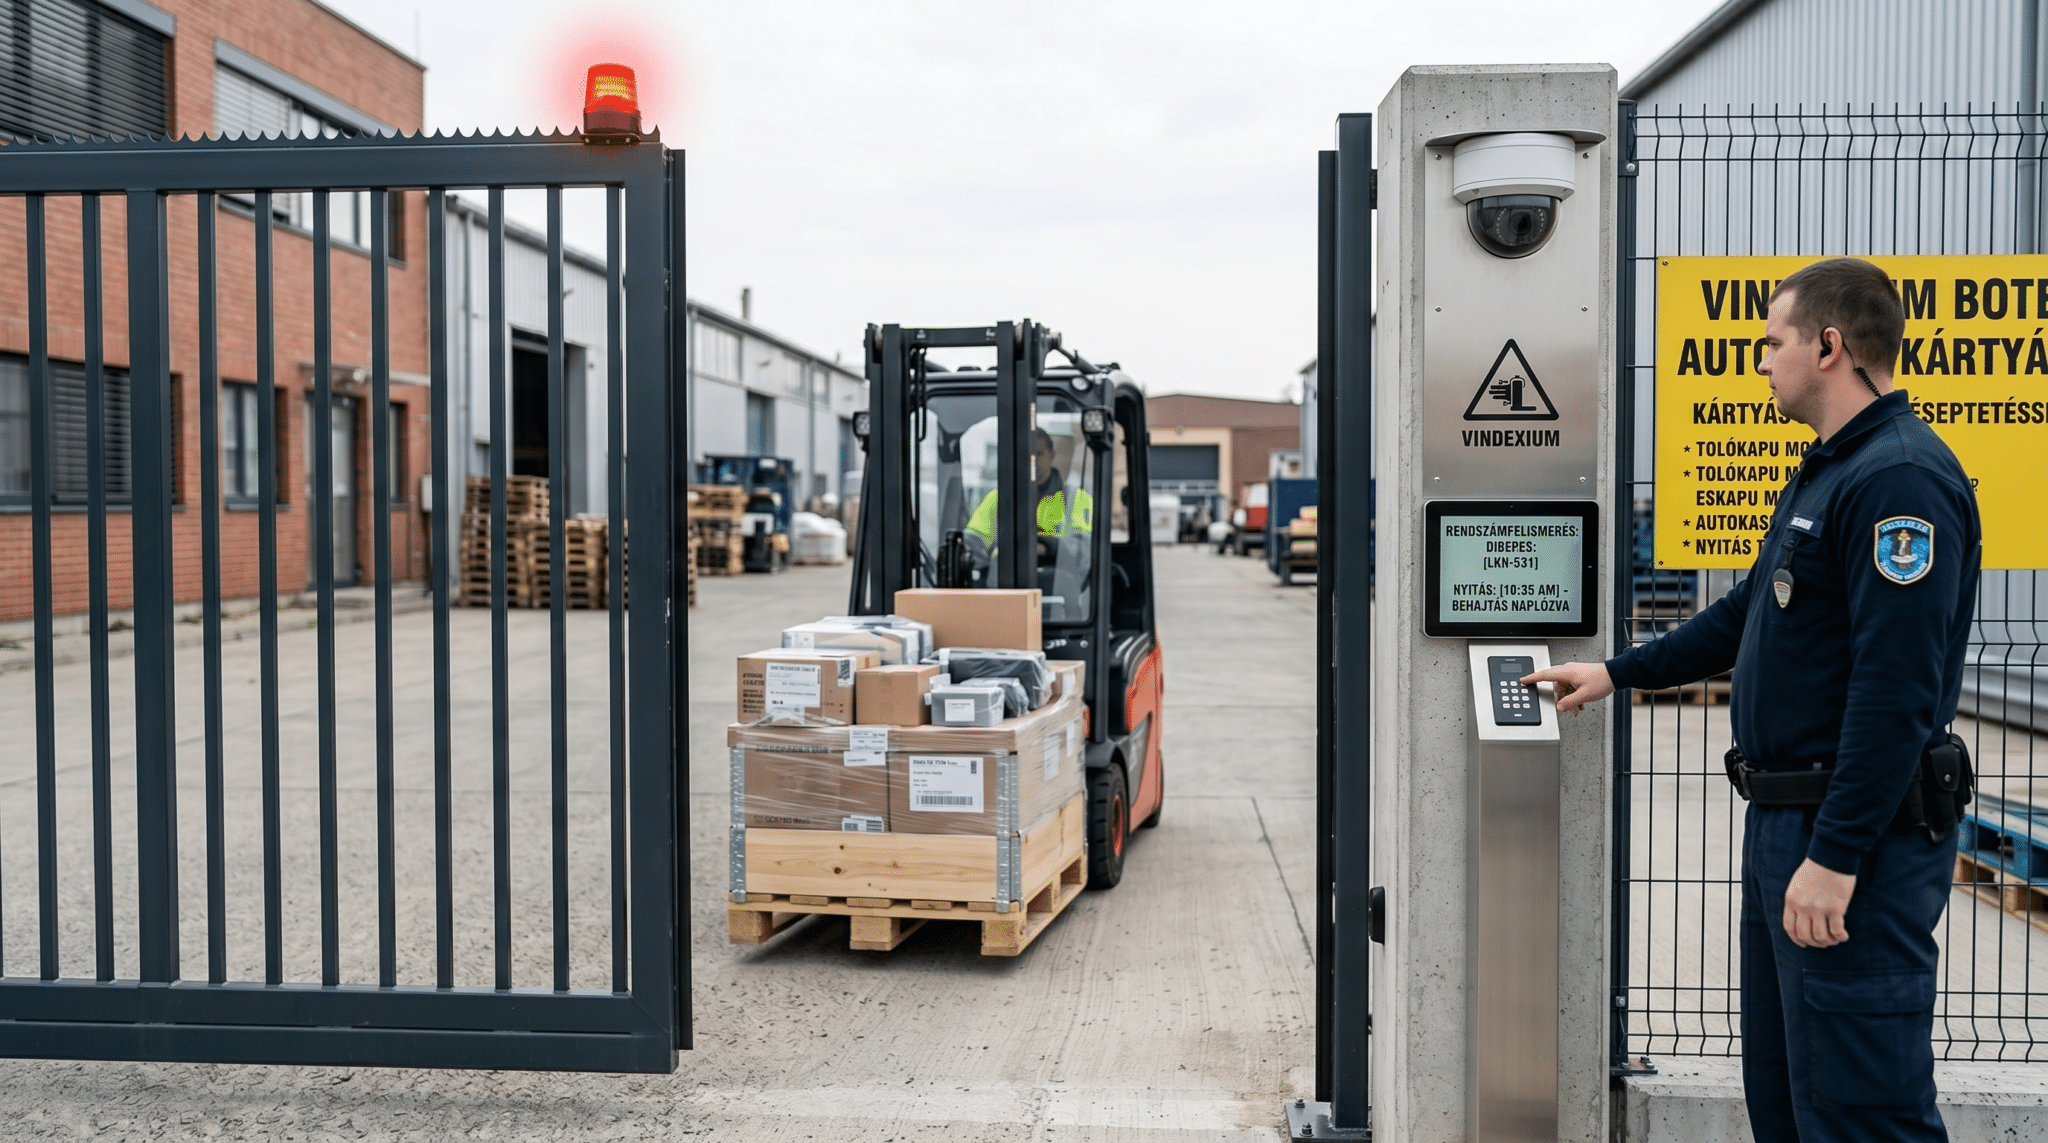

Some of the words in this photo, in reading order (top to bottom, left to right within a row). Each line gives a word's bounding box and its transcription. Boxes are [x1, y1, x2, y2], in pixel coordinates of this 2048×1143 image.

[1700, 279, 1783, 320] VIN
[1890, 279, 1936, 320] M
[1910, 396, 2048, 424] ÉSEPTETÉSS
[1461, 430, 1560, 447] VINDEXIUM
[1696, 437, 1779, 457] TOLÓKAPU
[1785, 441, 1814, 457] MO
[1695, 461, 1779, 482] TOLÓKAPU
[1696, 490, 1758, 506] ESKAPU
[1764, 490, 1783, 506] M
[1446, 522, 1579, 537] RENDSZÁMFELISMERÉS:
[1695, 514, 1773, 531] AUTOKAS
[1695, 535, 1752, 555] NYITÁS
[1483, 557, 1538, 570] [LKN-531]
[1453, 581, 1497, 596] NYITÁS:
[1499, 584, 1535, 598] [10:35
[1538, 584, 1560, 598] AM]
[1452, 597, 1509, 611] BEHAJTÁS
[1511, 597, 1570, 611] NAPLÓZVA
